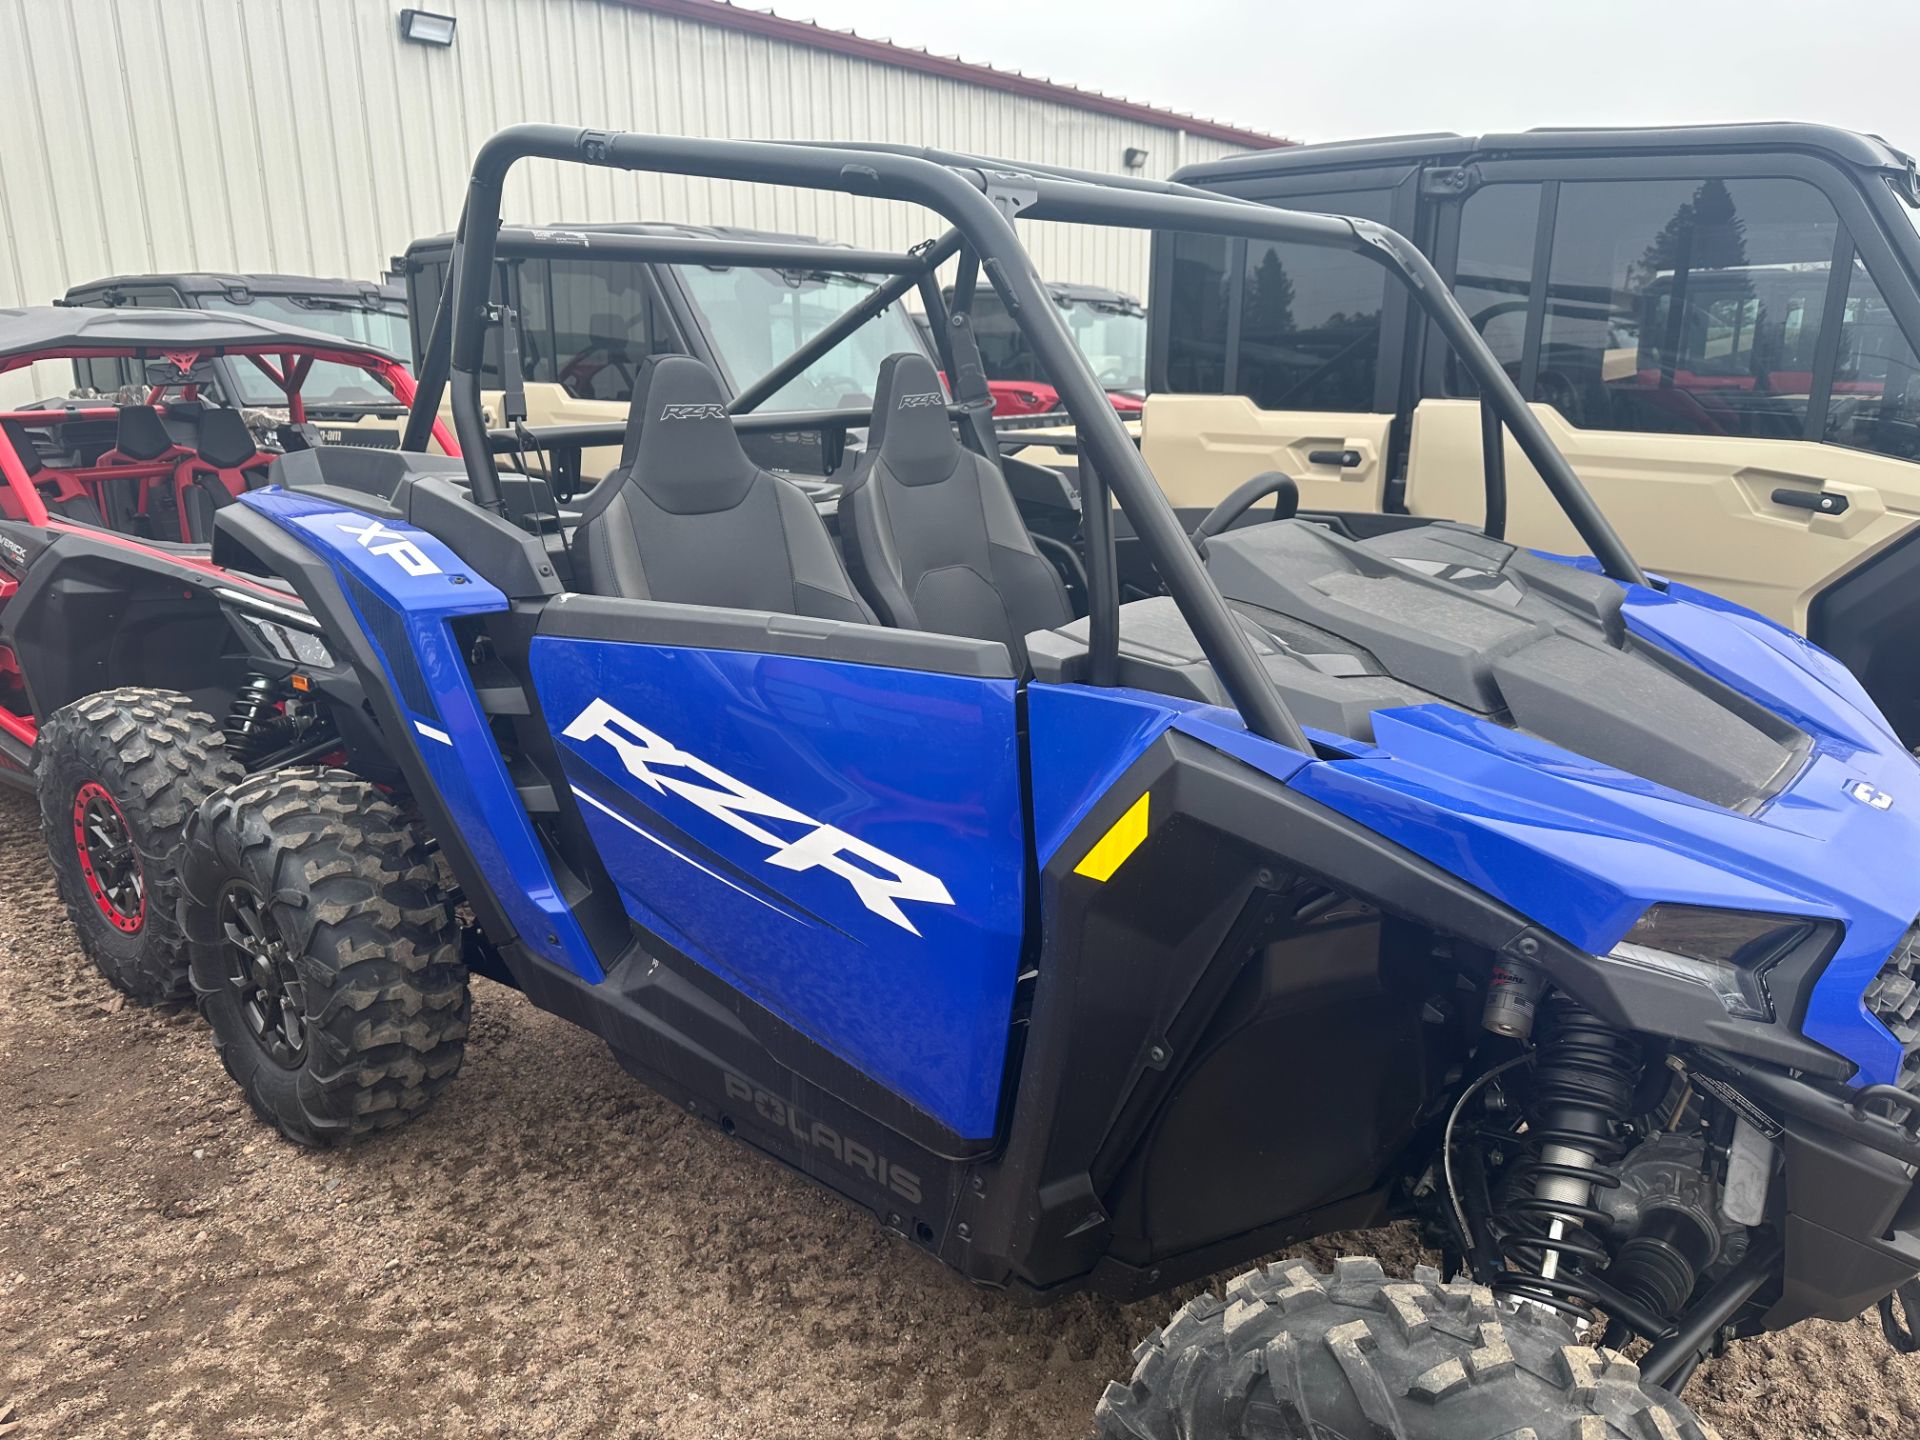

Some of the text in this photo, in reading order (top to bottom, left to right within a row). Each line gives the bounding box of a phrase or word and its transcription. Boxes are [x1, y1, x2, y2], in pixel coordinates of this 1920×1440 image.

[660, 403, 725, 421] RZR
[898, 393, 942, 409] RZR
[335, 521, 444, 577] XP
[562, 697, 957, 938] RZR
[723, 1070, 923, 1205] POLARIS
